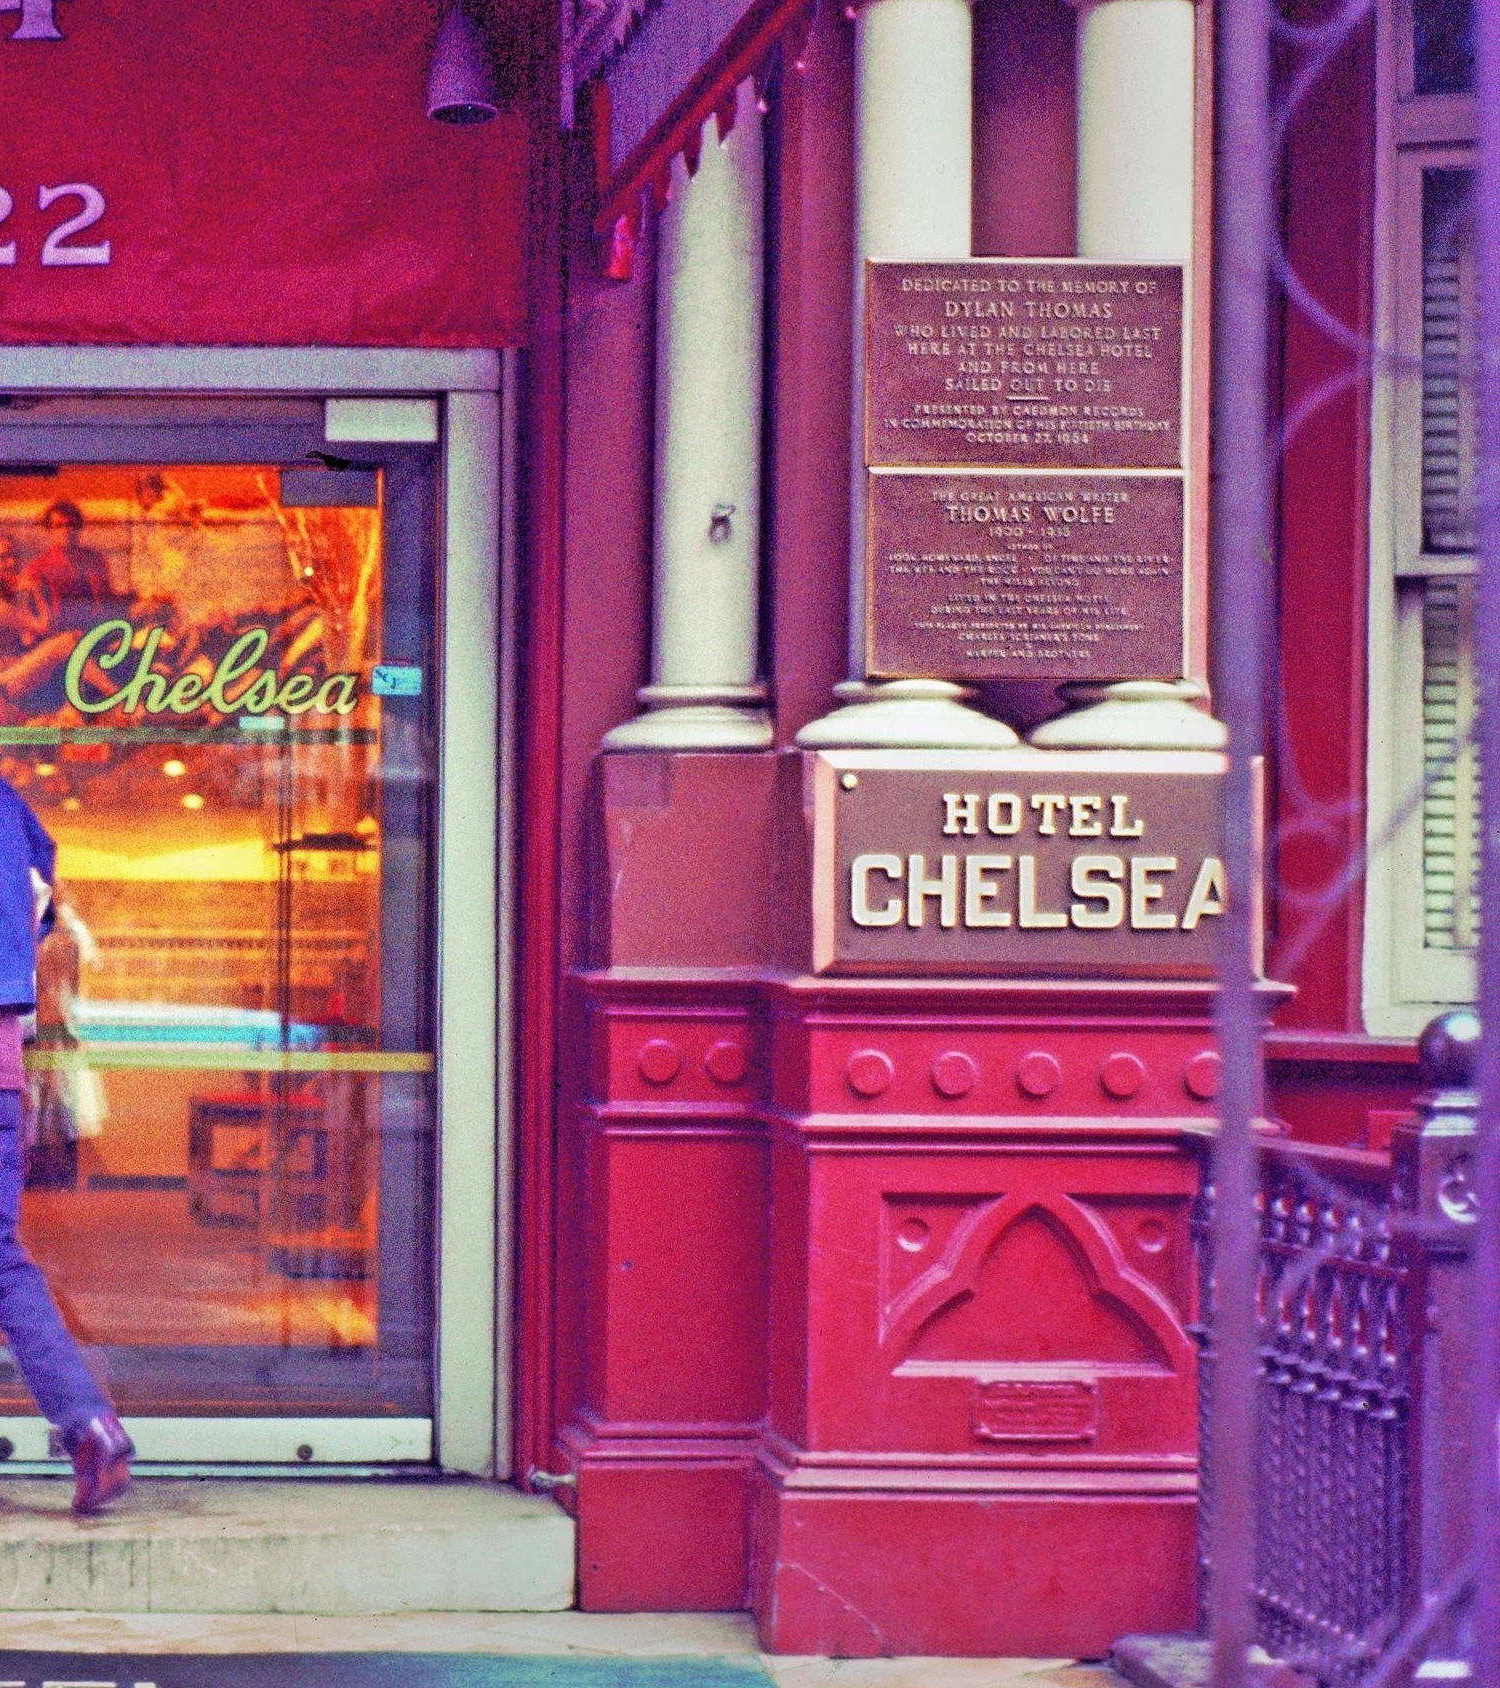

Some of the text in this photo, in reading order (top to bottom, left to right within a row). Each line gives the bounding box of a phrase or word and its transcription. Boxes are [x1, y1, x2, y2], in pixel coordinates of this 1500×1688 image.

[902, 278, 1157, 294] DEDICATED TO THE MEMORY OF
[945, 300, 1112, 319] DYLAN THOMAS
[893, 324, 1162, 340] WHO LIVED AND LABORED LAST
[907, 341, 1153, 358] HERE AT THE CHELSEA HOTEL
[958, 360, 1099, 375] AND FROM HERE
[945, 377, 1112, 393] SAILED OUT TO DIE
[914, 404, 985, 415] PRESENTED
[1083, 406, 1144, 417] RECORDS
[966, 432, 1029, 443] OCTOBER
[960, 491, 1000, 502] GREAT
[1008, 491, 1074, 502] AMERICAN
[1080, 492, 1129, 503] WRITER
[946, 505, 1114, 523] THOMAS WOLFE
[62, 616, 360, 717] Chelsea
[941, 792, 1145, 837] HOTEL
[850, 854, 1226, 931] CHELSEA
